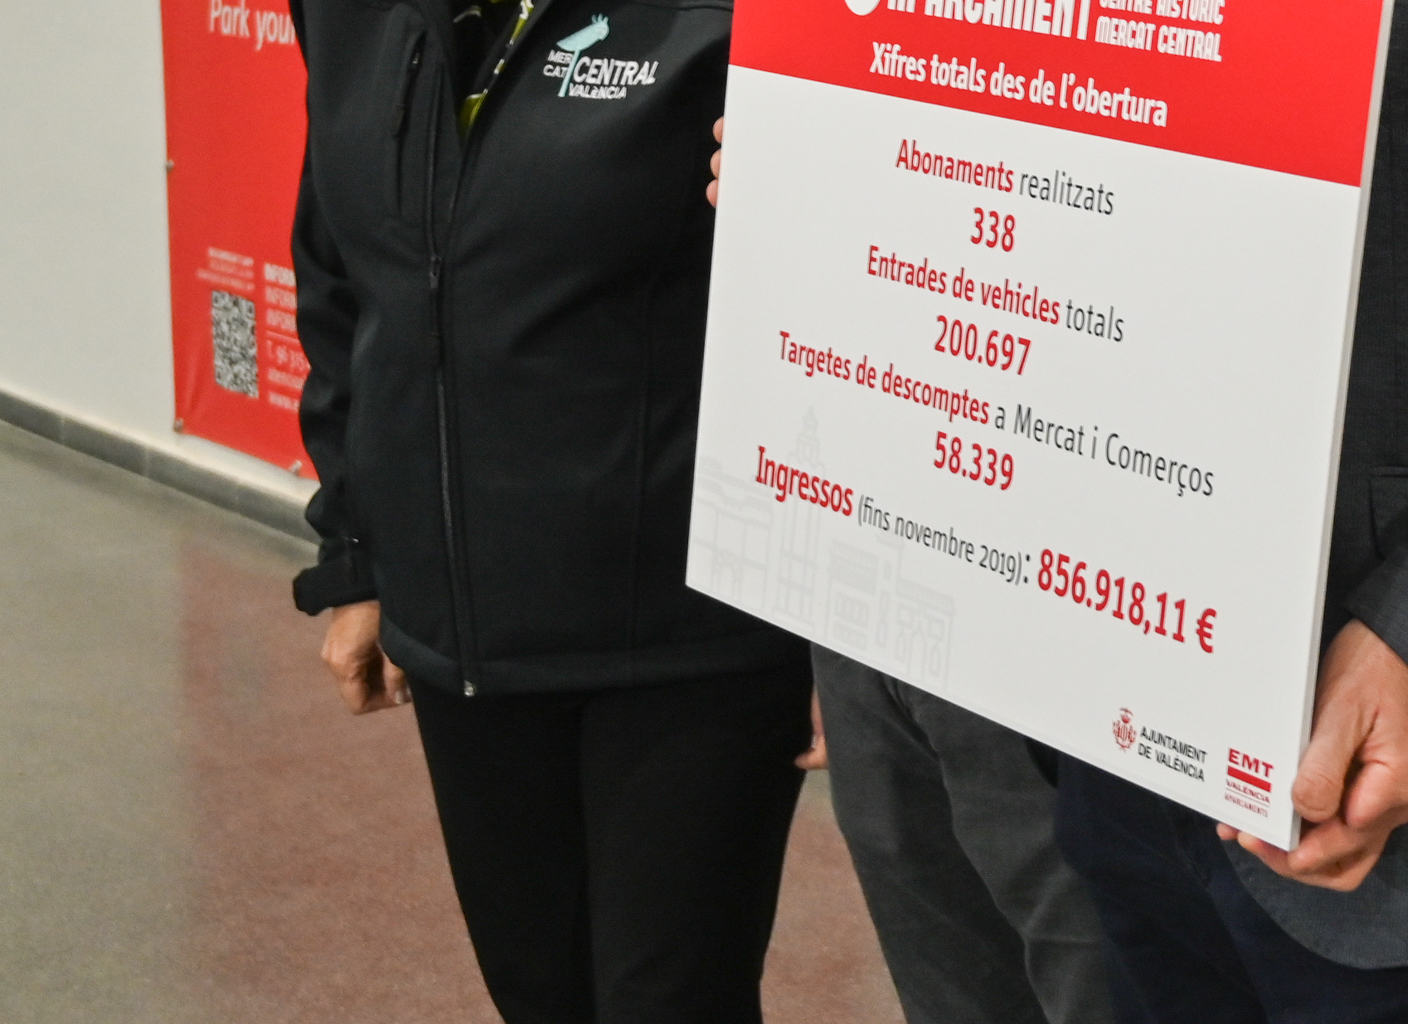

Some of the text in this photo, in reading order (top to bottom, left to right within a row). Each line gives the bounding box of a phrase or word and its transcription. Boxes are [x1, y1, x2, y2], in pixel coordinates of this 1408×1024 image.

[547, 49, 574, 64] MER
[1095, 17, 1222, 62] MERCAT CENTRAL
[543, 64, 569, 78] CAT
[573, 56, 659, 86] CENTRAL
[869, 41, 926, 82] Xifres
[931, 54, 986, 94] totals
[990, 63, 1026, 100] des
[1029, 69, 1055, 106] de
[895, 138, 1114, 216] Abonaments realitzats
[971, 206, 1016, 252] 338
[867, 245, 1125, 343] Entrades de vehicles totals
[933, 314, 1032, 376] 200.697
[778, 330, 1215, 498] Targetes de descomptes a Mercat i Comerços
[932, 430, 1015, 492] 58.339
[754, 444, 854, 518] Ingressos
[857, 494, 891, 532] (fins
[895, 513, 975, 565] novembre
[1037, 548, 1187, 644] 856.918,11
[1196, 607, 1218, 654] €
[1137, 743, 1152, 760] DE
[1139, 726, 1208, 764] AJUNTAMENT
[1228, 747, 1275, 778] EMT
